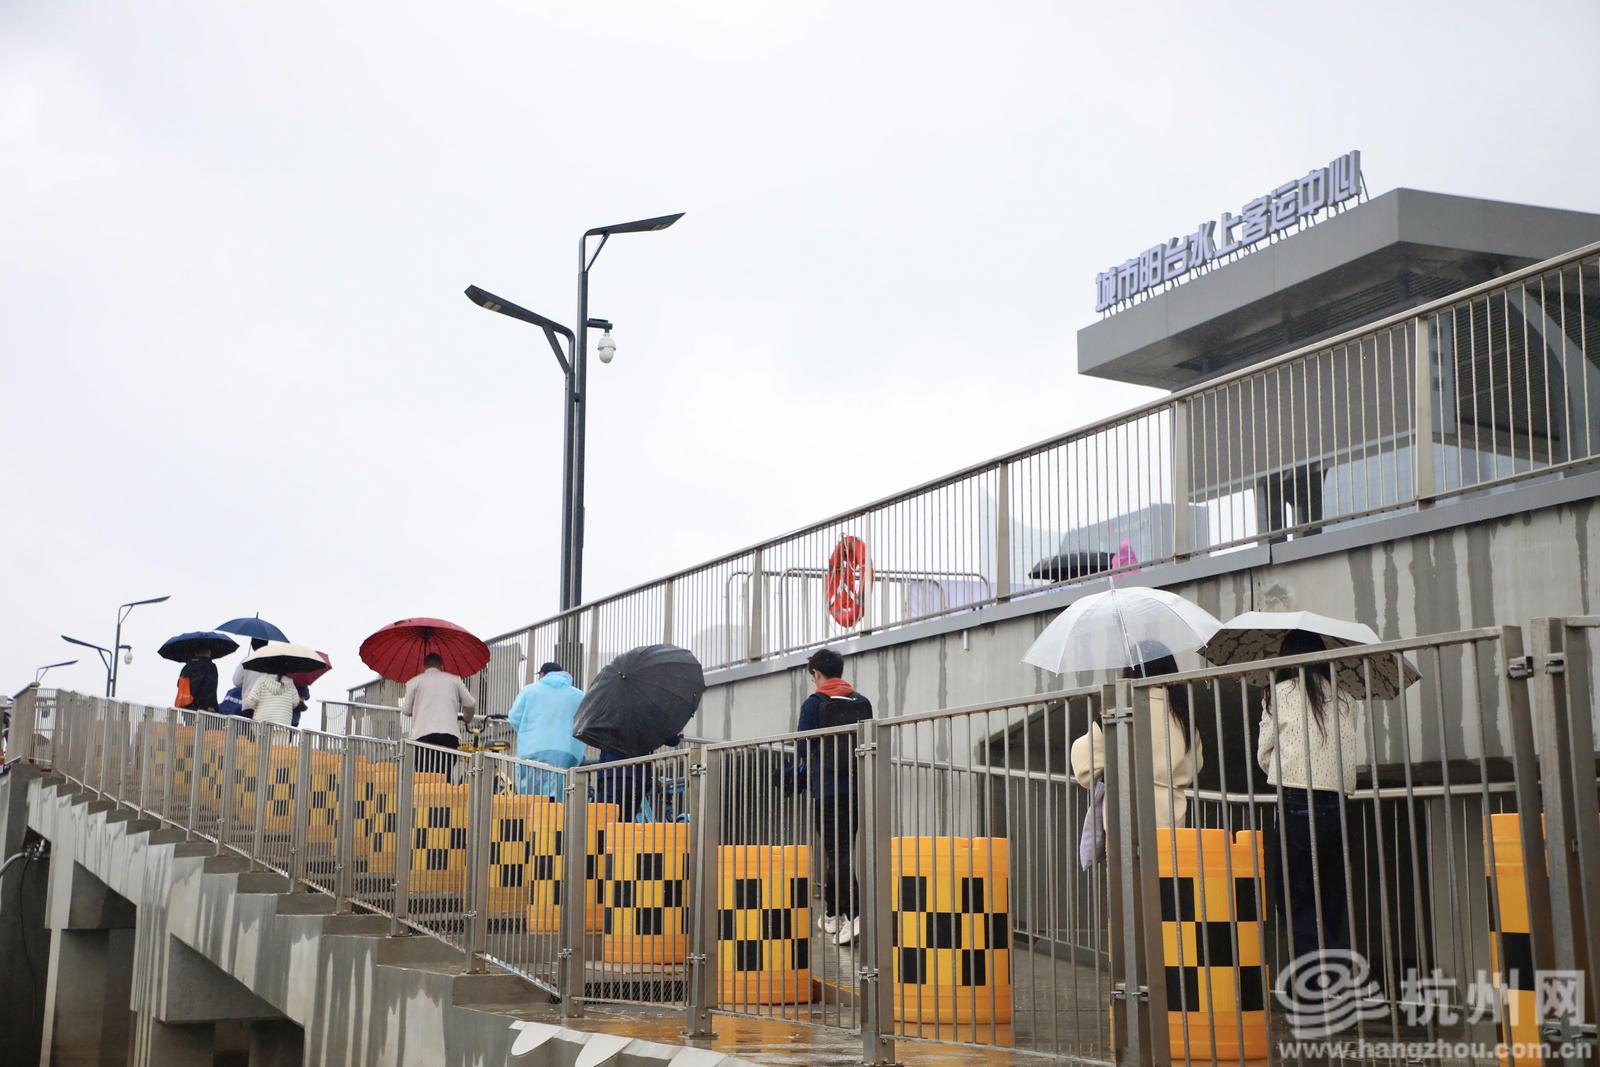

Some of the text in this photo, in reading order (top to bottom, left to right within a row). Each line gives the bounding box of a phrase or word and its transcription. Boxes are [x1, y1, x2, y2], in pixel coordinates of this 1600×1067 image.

[1095, 150, 1361, 312] 城市阳台水上客运中心
